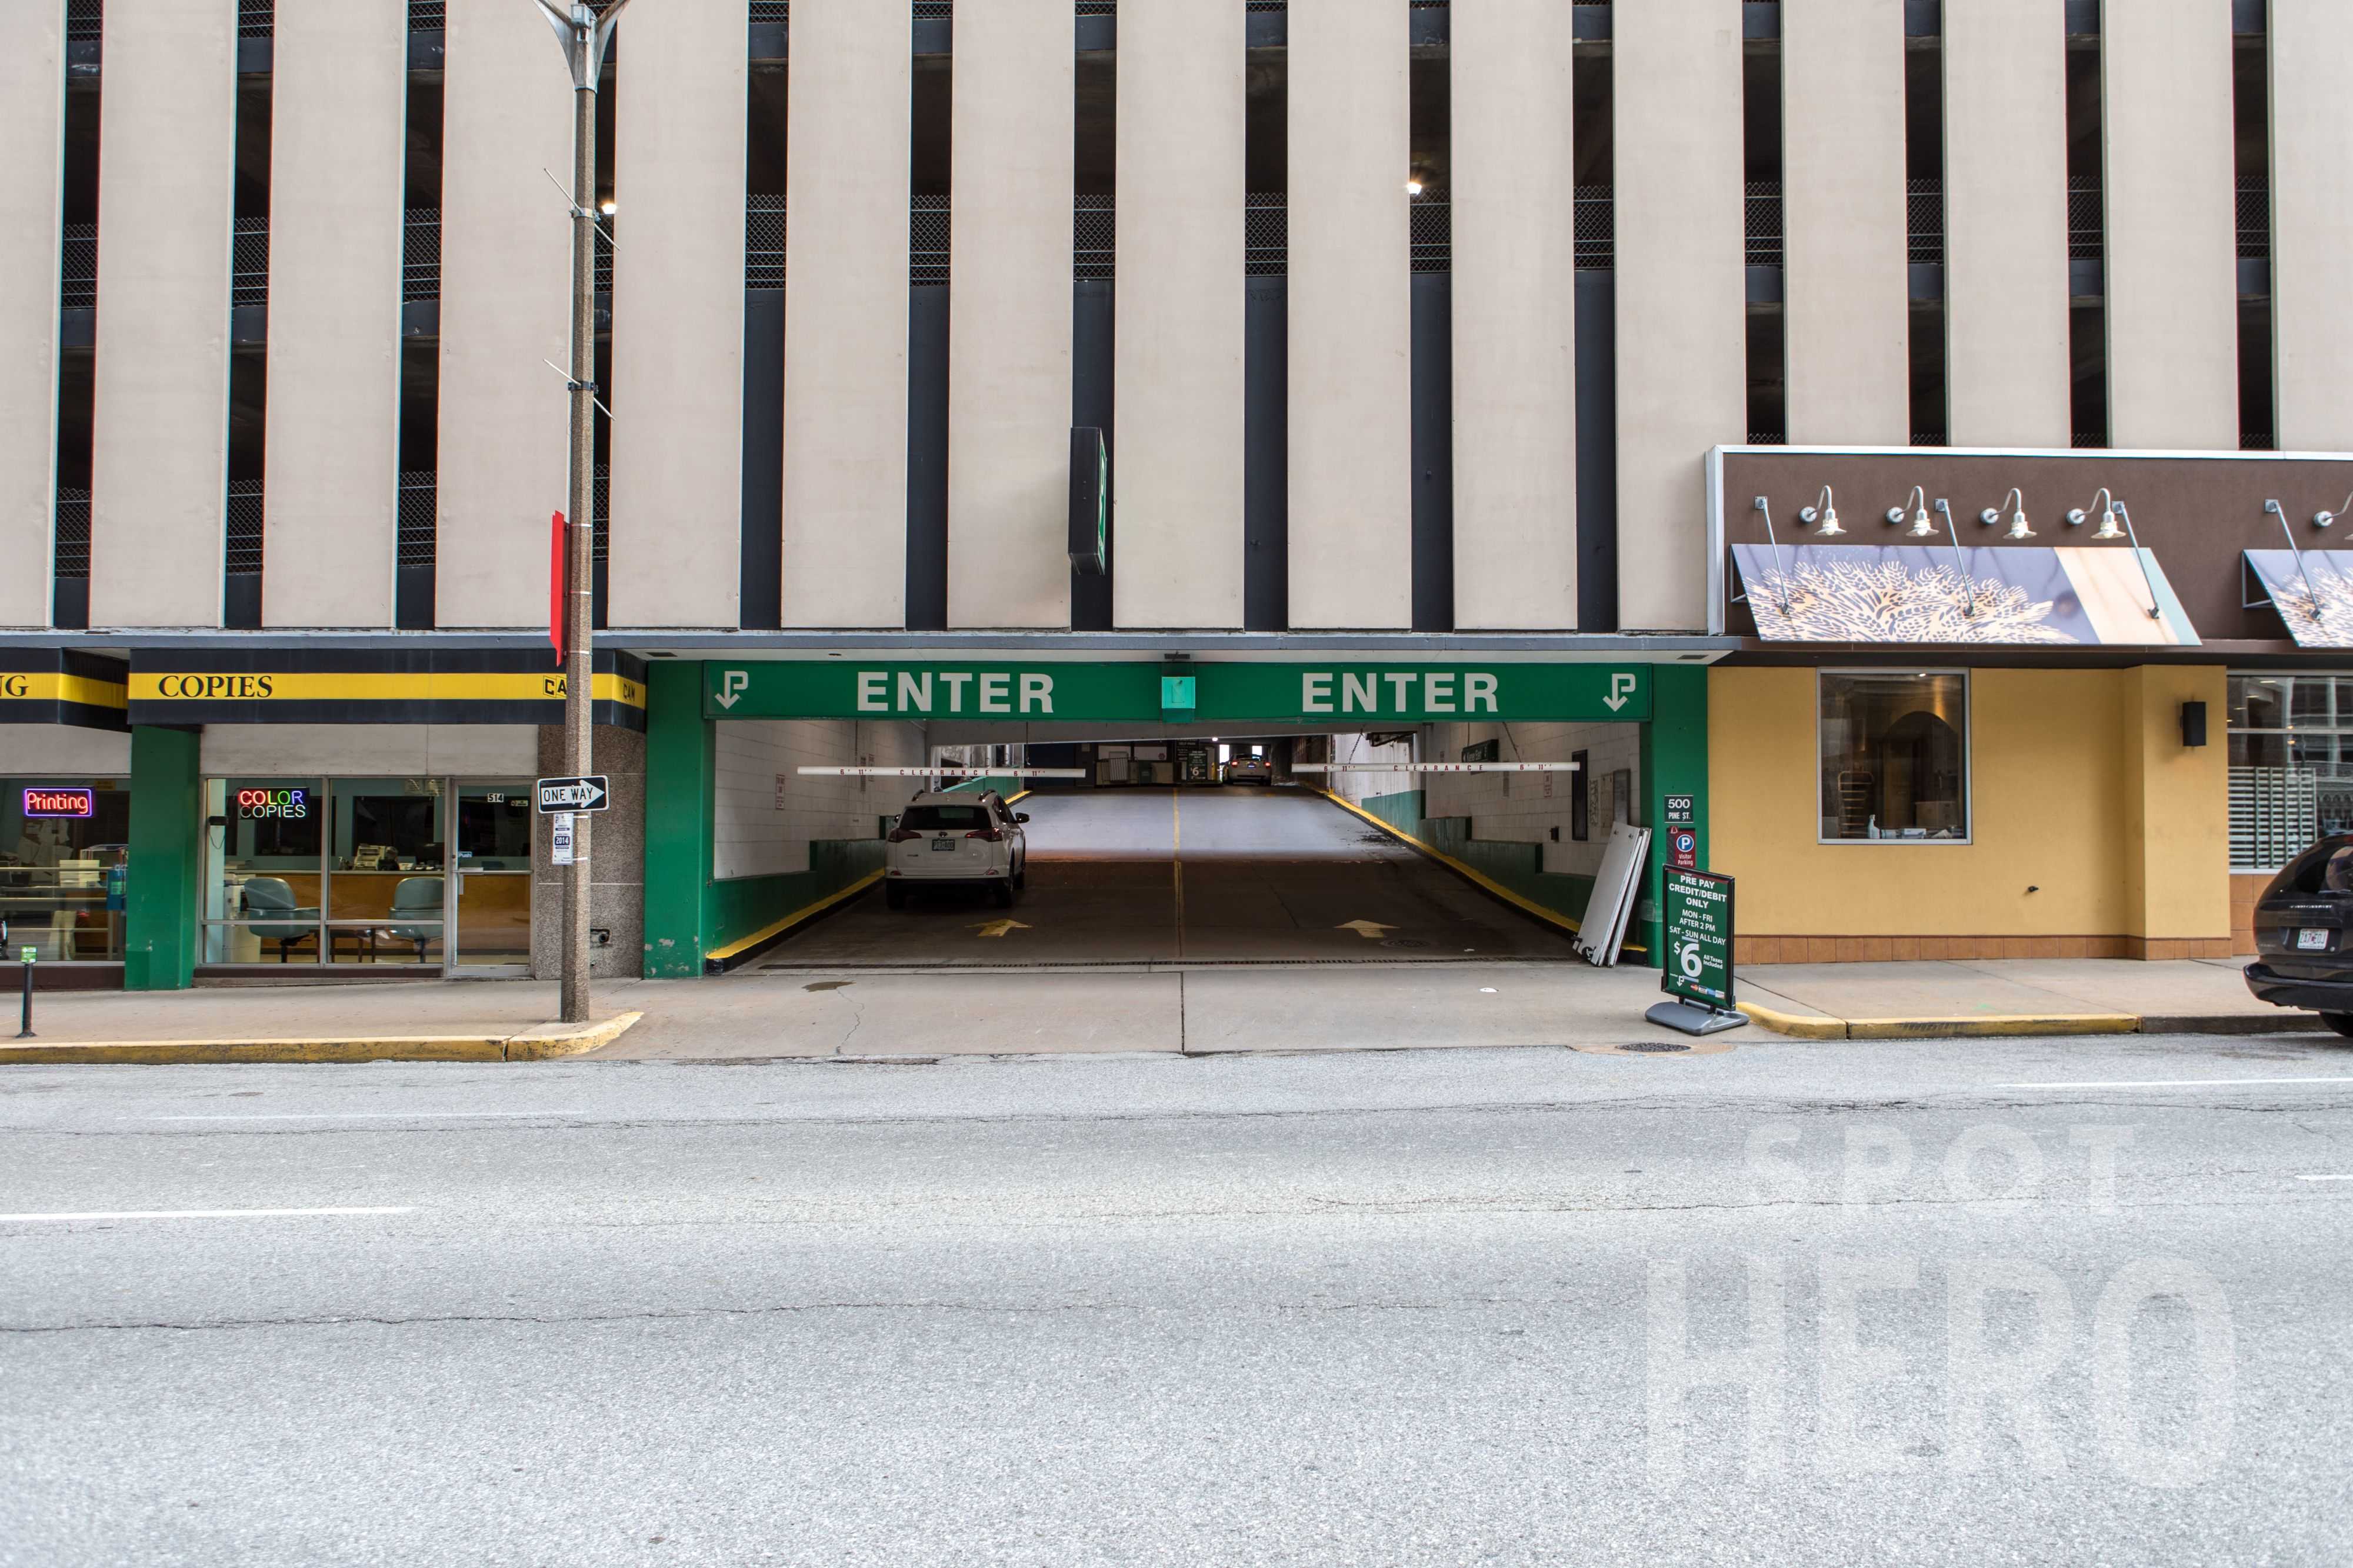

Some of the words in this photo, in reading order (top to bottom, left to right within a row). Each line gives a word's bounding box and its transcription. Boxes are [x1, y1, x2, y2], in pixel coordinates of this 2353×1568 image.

[158, 675, 273, 698] COPIES
[545, 679, 567, 695] CA
[857, 672, 1054, 713] ENTER
[1302, 672, 1498, 712] ENTER
[239, 790, 304, 805] COLOR
[544, 789, 566, 802] ONE
[571, 788, 594, 800] WAY
[27, 792, 88, 814] Printing
[1668, 799, 1691, 809] 500
[239, 804, 306, 818] COPIES
[1681, 837, 1691, 849] P
[1680, 875, 1697, 885] PRE
[1699, 879, 1715, 889] PAY
[1668, 883, 1727, 902] CREDIT/DEBIT
[1686, 897, 1709, 909] ONLY
[1682, 909, 1698, 919] MON
[1702, 914, 1712, 922] FRI
[1679, 918, 1699, 928] AFTER
[1705, 923, 1715, 932] PM
[1669, 926, 1681, 934] SAT
[1685, 929, 1698, 939] SUN
[1699, 933, 1711, 942] ALL
[1712, 936, 1726, 945] DAY
[1703, 960, 1723, 969] Included
